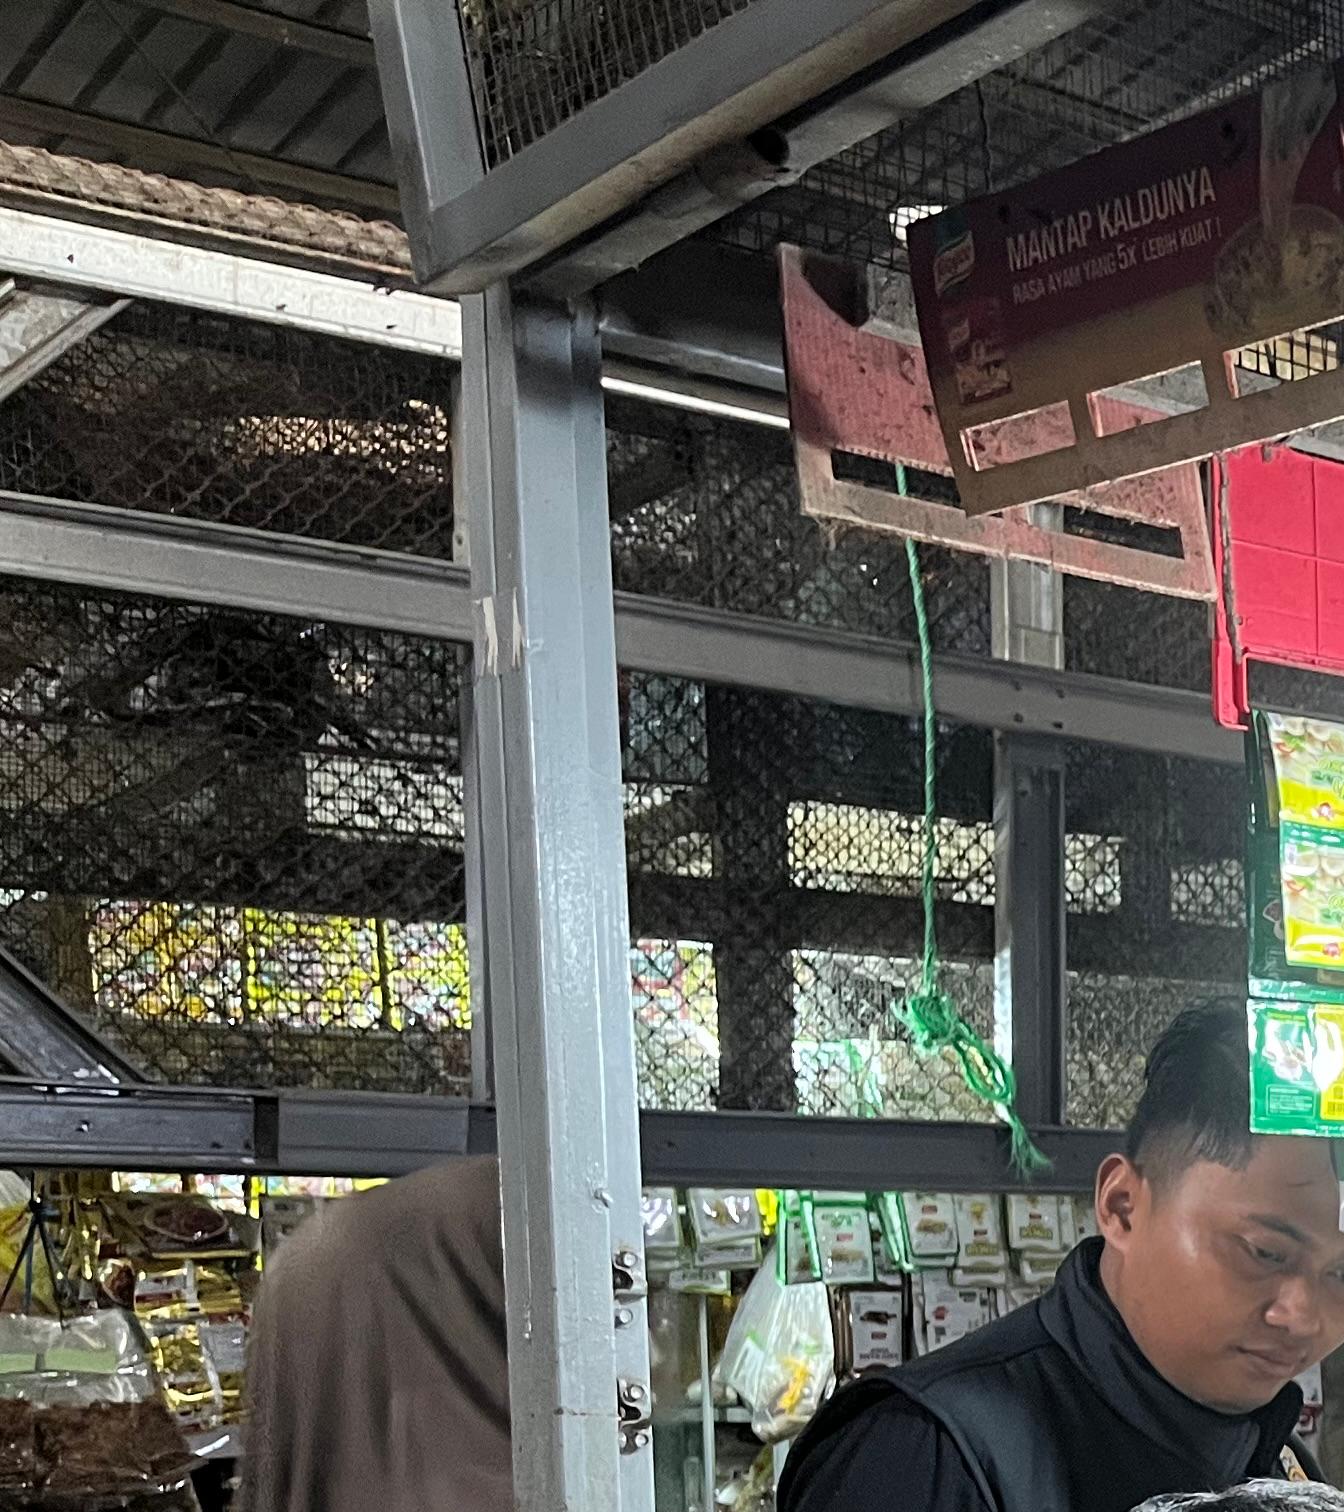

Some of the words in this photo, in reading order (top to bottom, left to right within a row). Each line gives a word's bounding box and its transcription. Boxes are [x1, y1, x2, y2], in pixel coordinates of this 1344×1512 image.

[1005, 211, 1094, 272] MANTAP
[1098, 166, 1217, 240] KALDUNYA
[1012, 278, 1046, 305] RASA
[1047, 266, 1081, 297] AYAM
[1083, 255, 1117, 287] YANG
[1142, 233, 1179, 261] LEBIH
